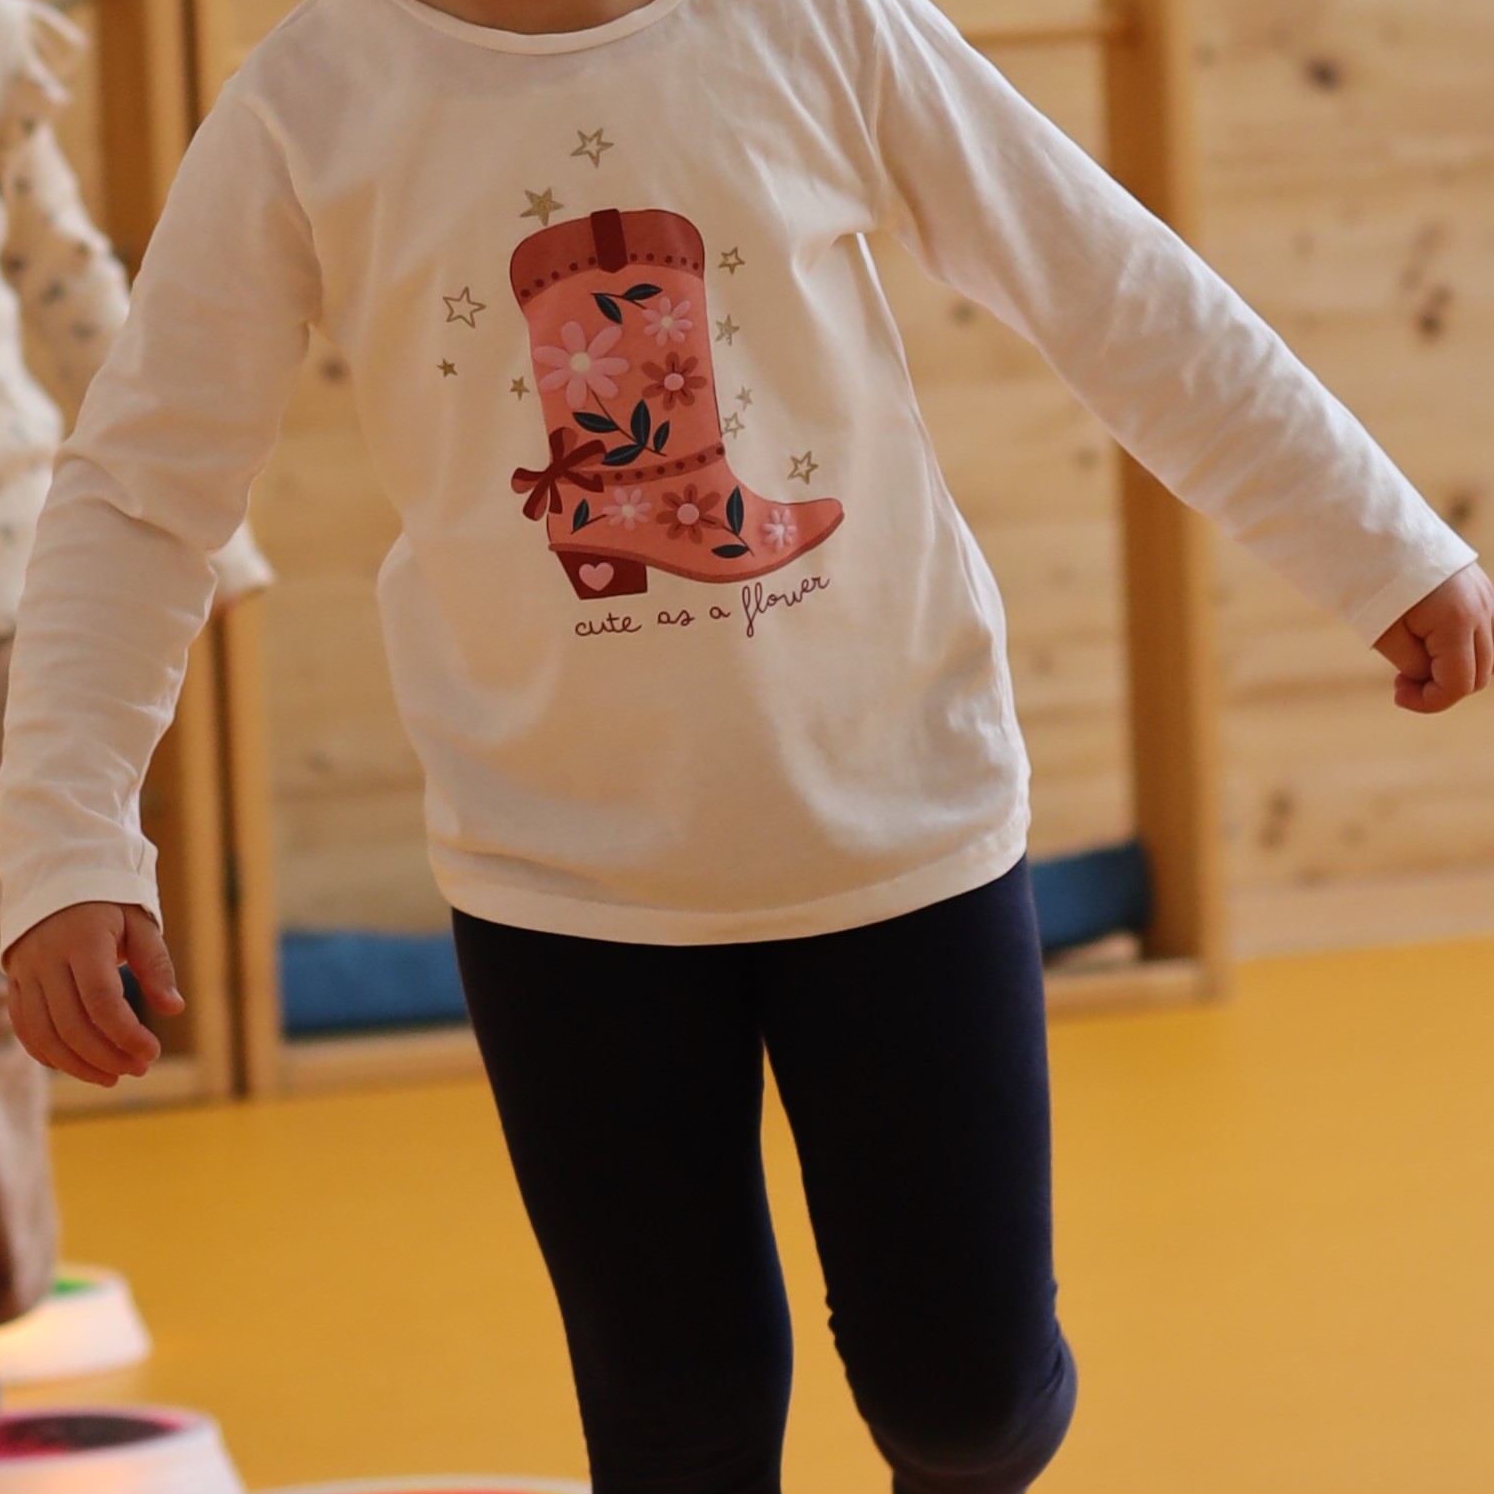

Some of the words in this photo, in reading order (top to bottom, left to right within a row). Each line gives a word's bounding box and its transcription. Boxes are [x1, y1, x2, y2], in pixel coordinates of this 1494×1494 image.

[574, 612, 642, 637] cute
[657, 609, 695, 627] as
[709, 606, 731, 620] a
[741, 575, 830, 638] flower
